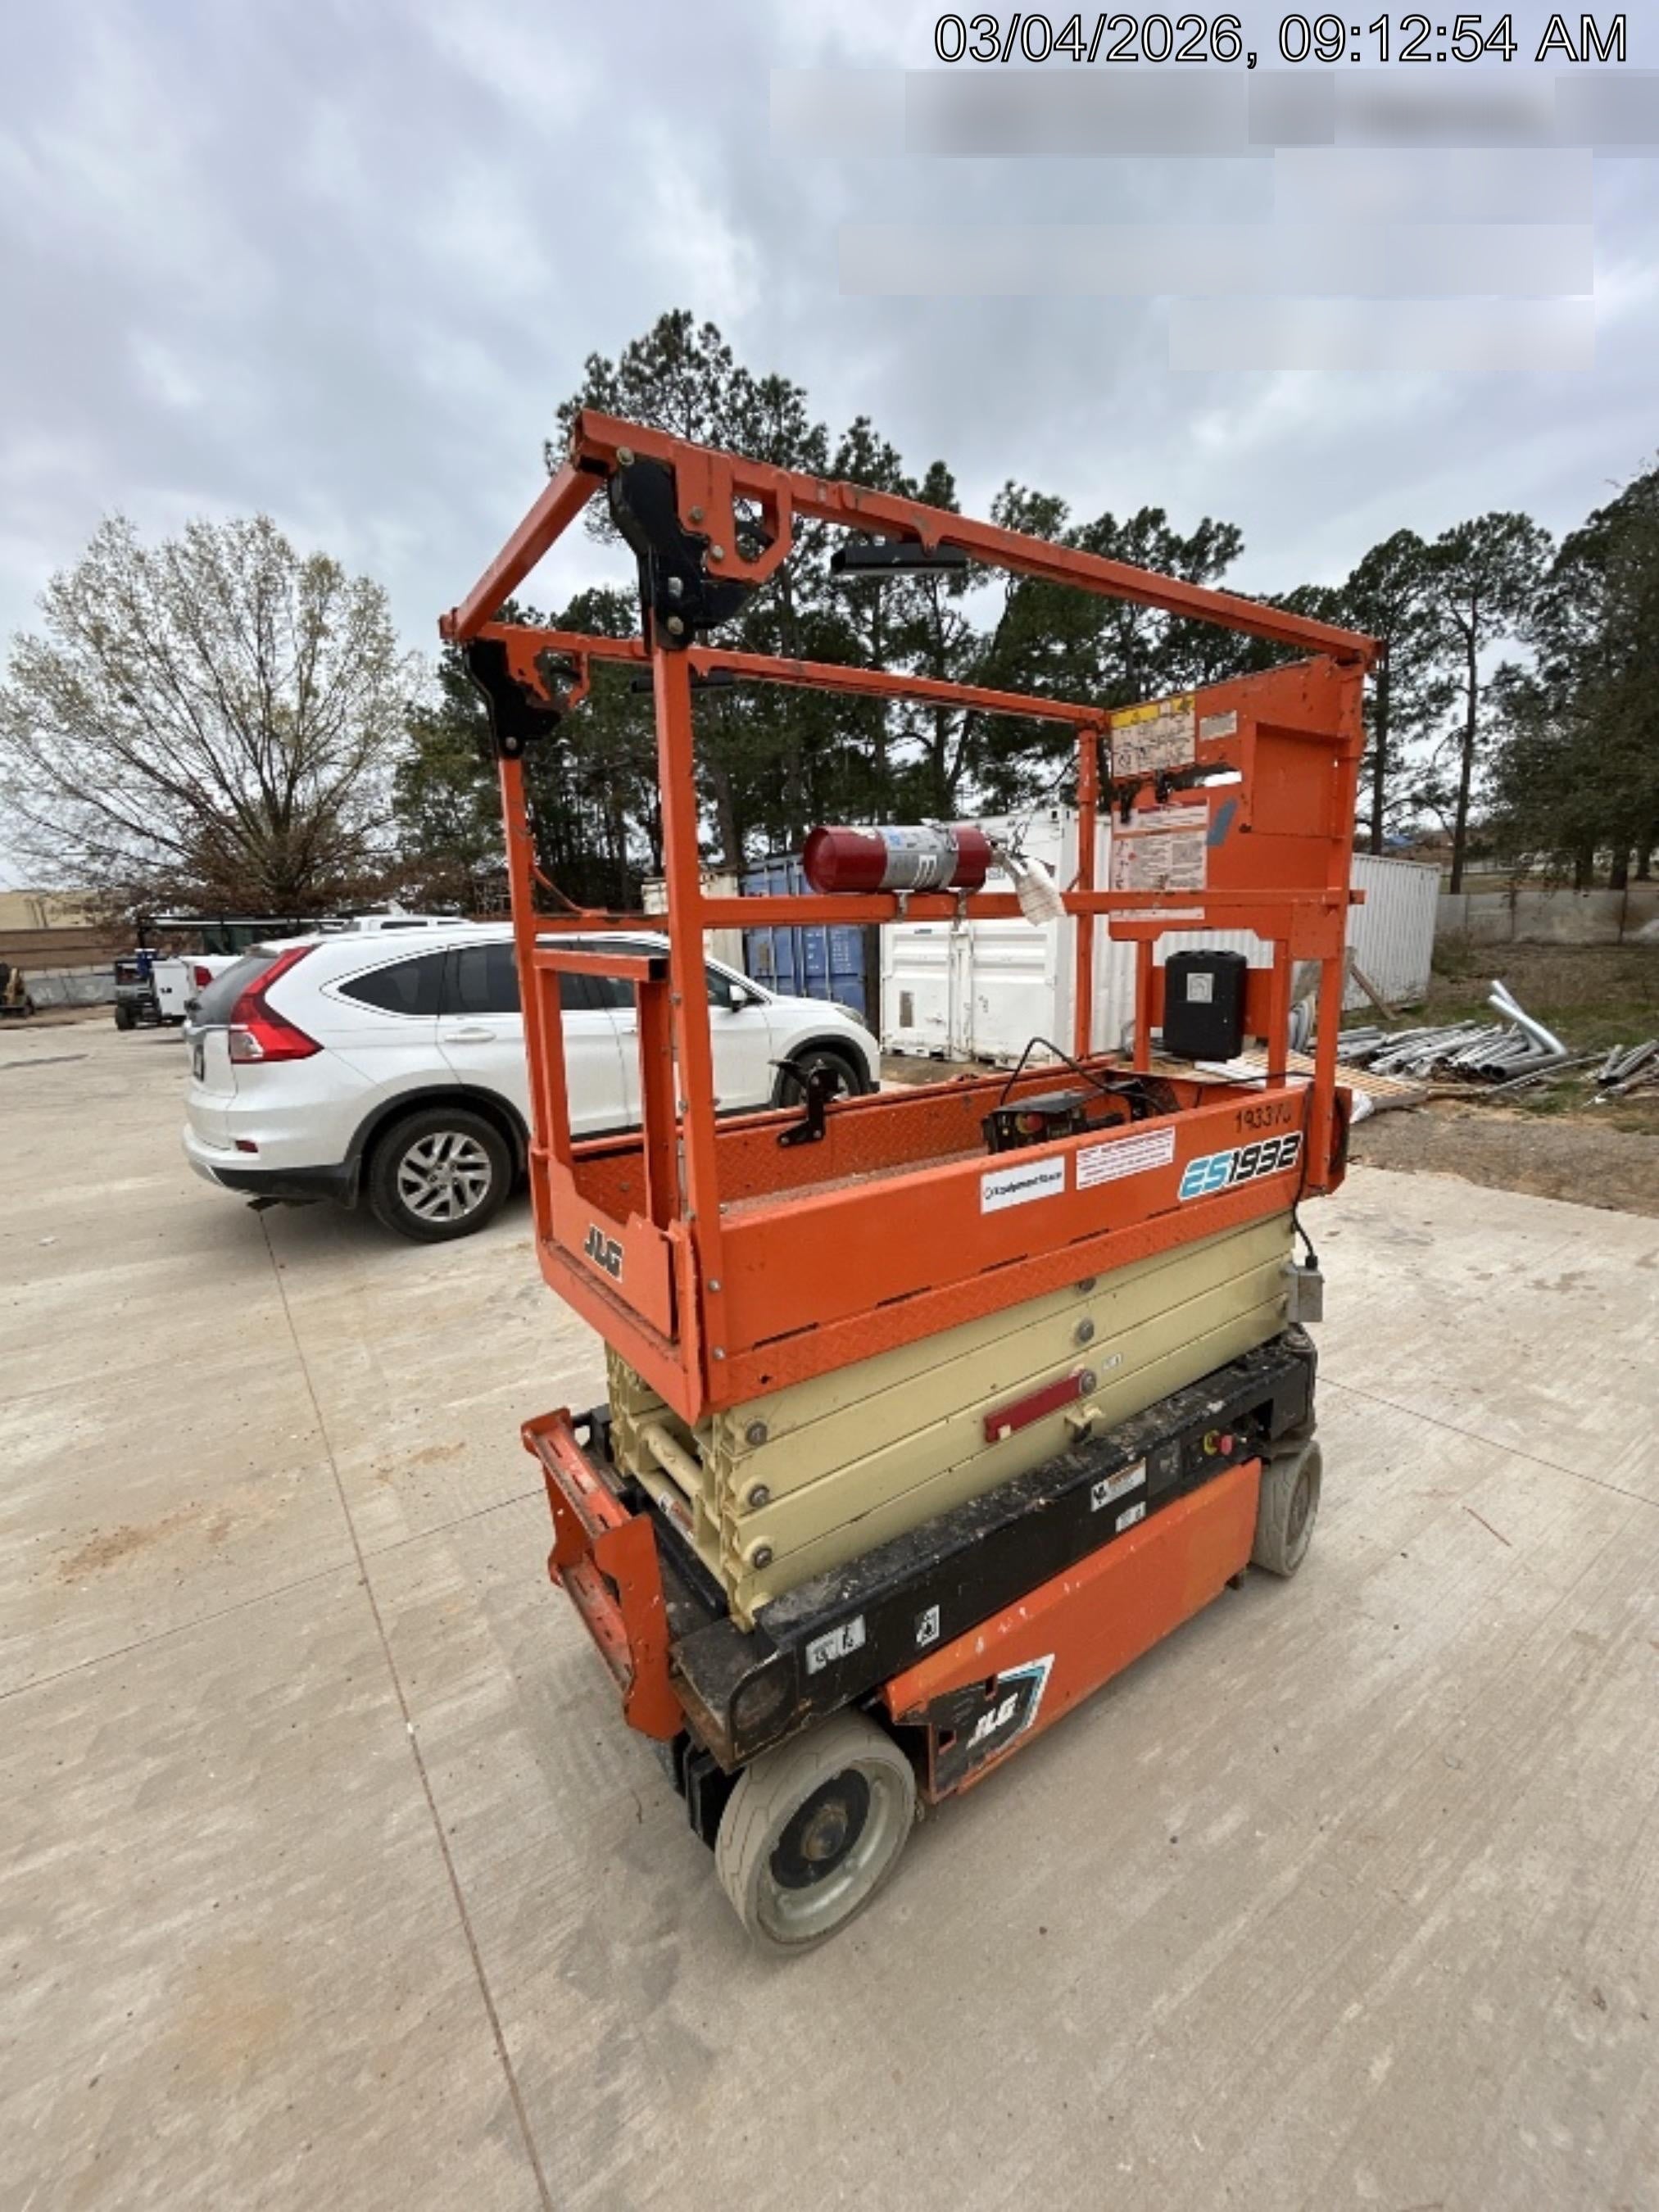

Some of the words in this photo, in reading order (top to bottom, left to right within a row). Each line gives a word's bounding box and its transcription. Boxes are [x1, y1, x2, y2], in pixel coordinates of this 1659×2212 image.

[1178, 1132, 1302, 1200] ES1932
[583, 1224, 623, 1283] JLG
[965, 1692, 1019, 1751] JLG
